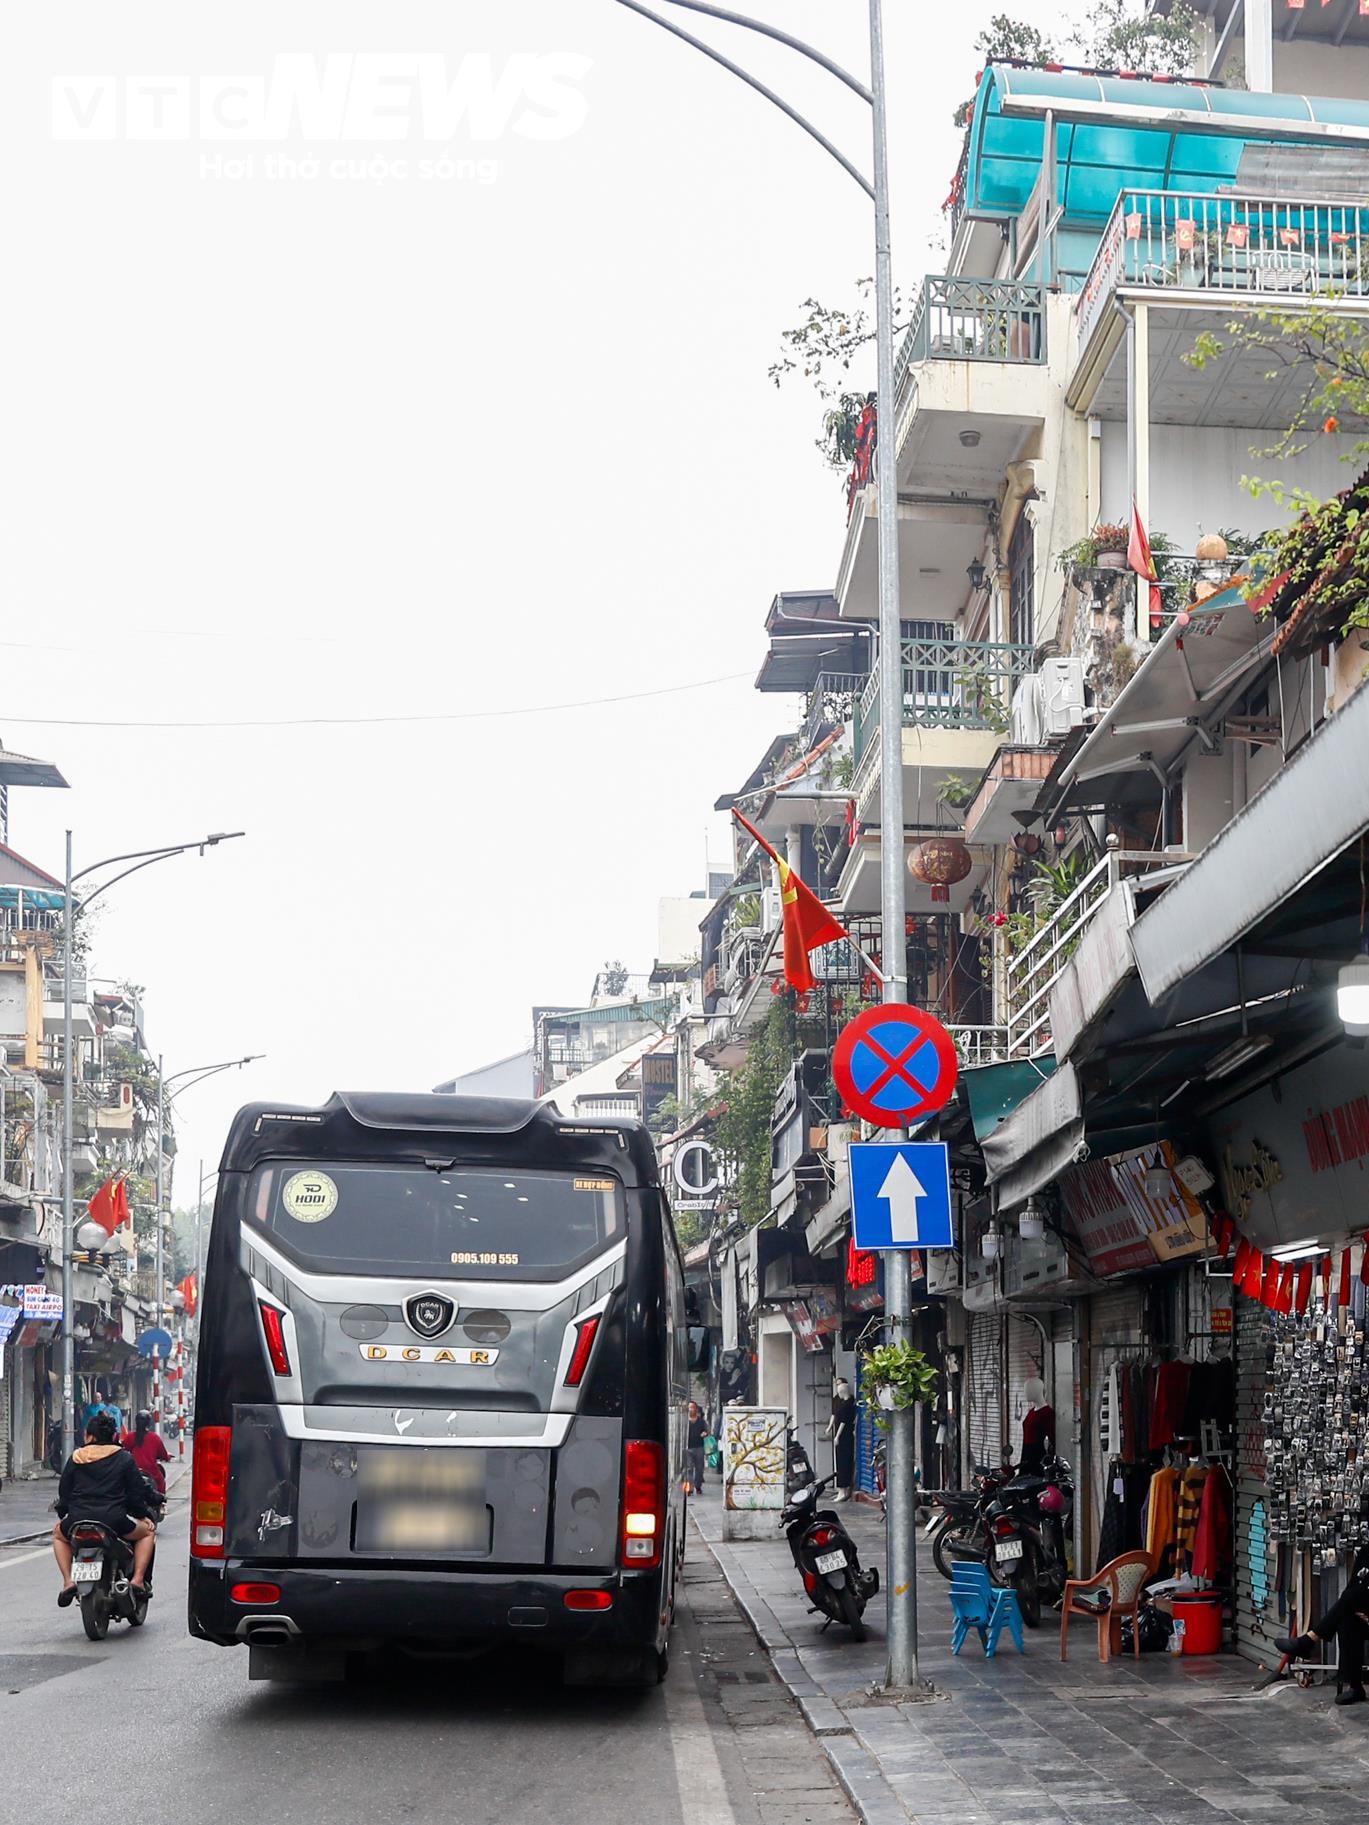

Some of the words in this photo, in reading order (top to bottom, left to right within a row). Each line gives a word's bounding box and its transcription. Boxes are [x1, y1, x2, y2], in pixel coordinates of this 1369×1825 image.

[295, 1195, 326, 1203] HODI
[451, 1252, 497, 1264] 0905.109
[498, 1254, 518, 1265] 555
[368, 1346, 488, 1363] DCAR
